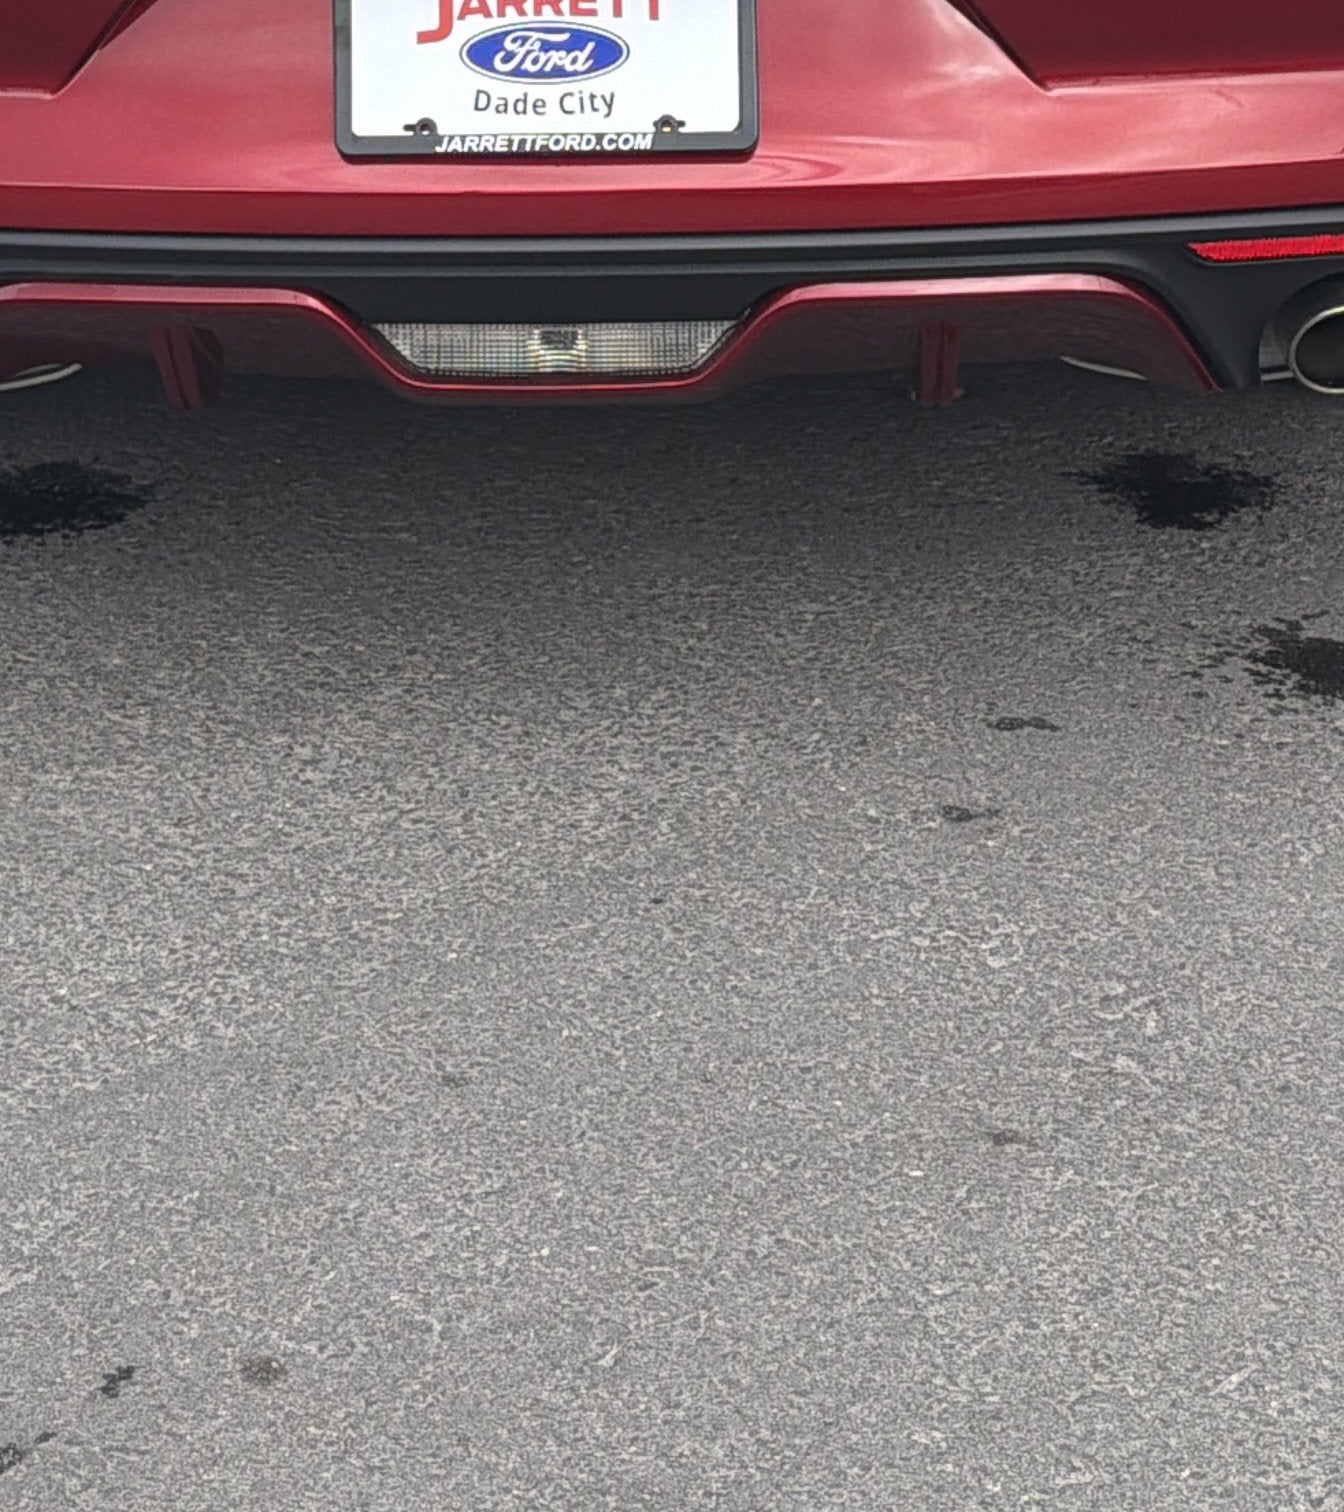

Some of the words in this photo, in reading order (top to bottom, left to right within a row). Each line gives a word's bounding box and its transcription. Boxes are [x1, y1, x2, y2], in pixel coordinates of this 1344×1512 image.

[492, 28, 595, 74] Ford
[473, 88, 548, 116] Dade
[559, 90, 616, 118] City
[434, 132, 654, 153] JARRETTFORD.COM
